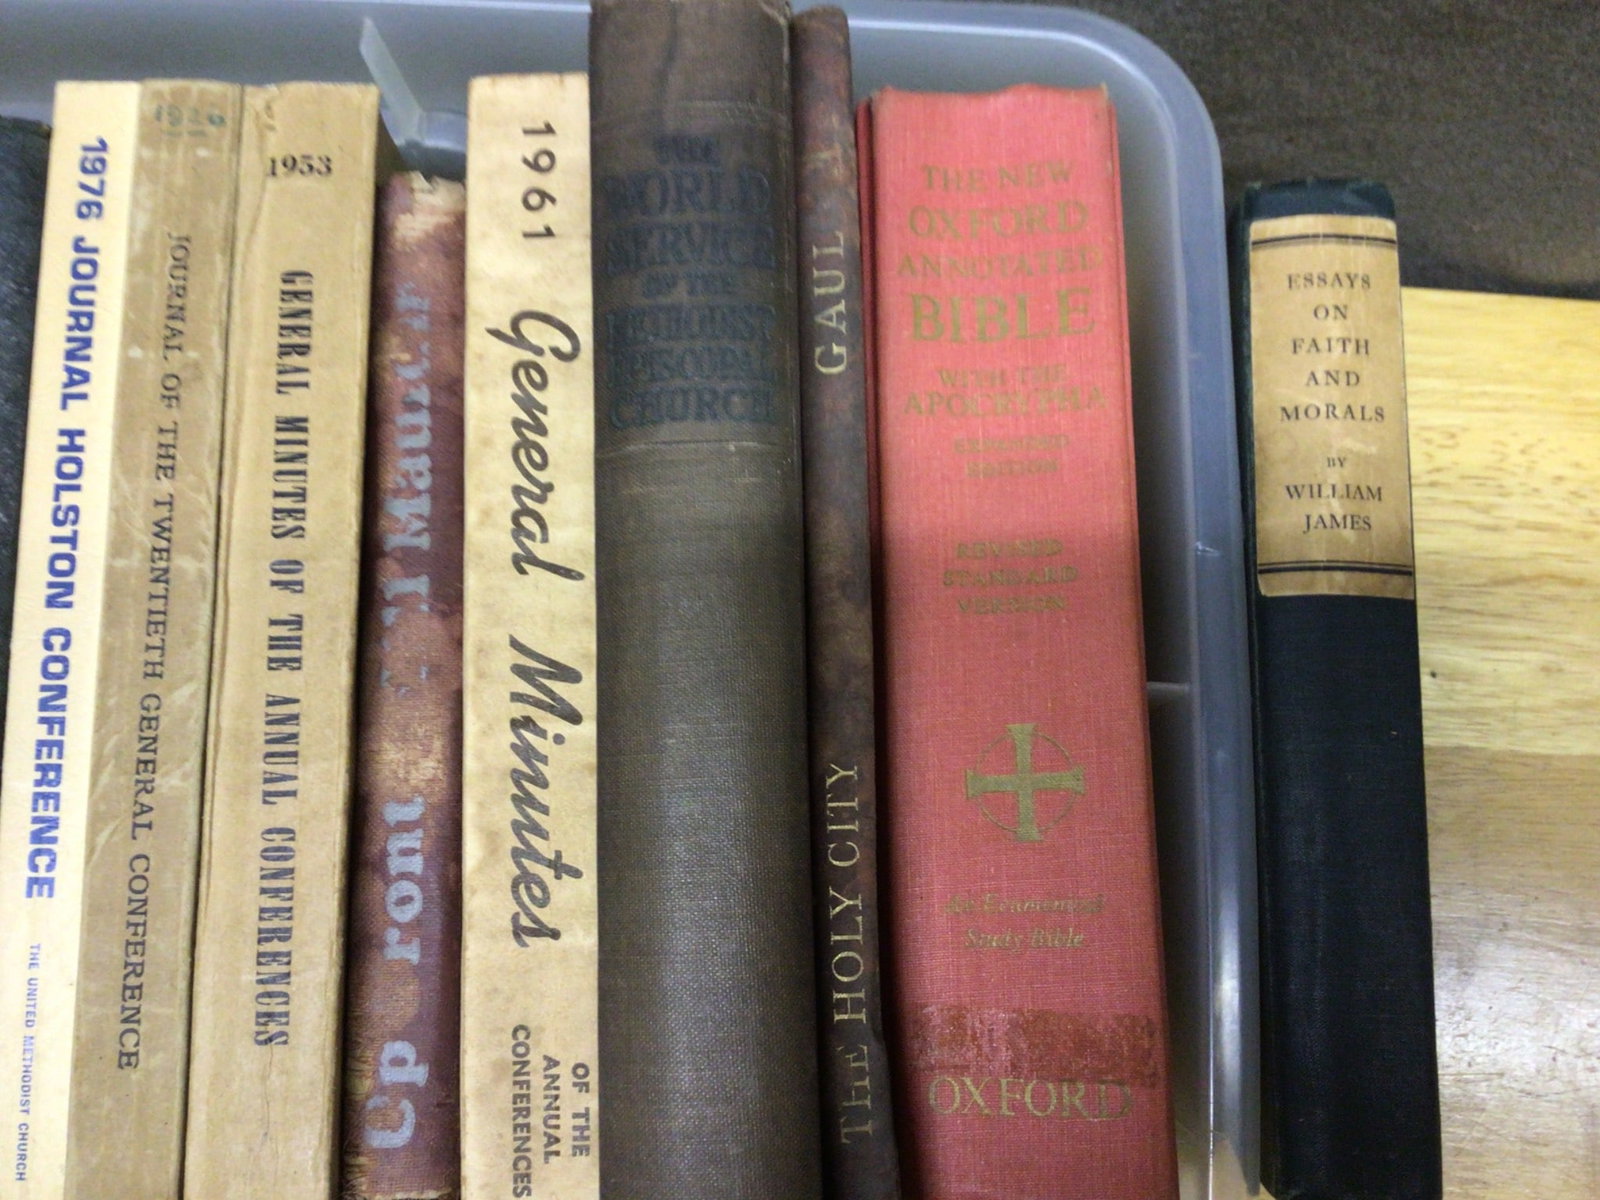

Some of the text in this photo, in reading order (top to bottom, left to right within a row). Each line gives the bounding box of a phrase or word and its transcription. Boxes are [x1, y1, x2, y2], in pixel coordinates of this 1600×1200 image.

[267, 153, 333, 178] 1953
[921, 159, 1074, 193] THE NEW
[907, 199, 1090, 241] OXFORD
[897, 245, 1104, 280] ANNOTATED
[1287, 271, 1372, 290] ESSAYS
[812, 230, 847, 376] GAUL
[909, 286, 1097, 344] BIBLE
[1313, 303, 1349, 322] ON
[1291, 336, 1370, 356] FAITH
[1305, 370, 1361, 387] AND
[609, 383, 777, 430] CHURCH
[1280, 403, 1386, 422] MORALS
[1326, 456, 1347, 469] BY
[1285, 482, 1384, 502] WILLIAM
[25, 137, 109, 900] 1976 JOURNAL HOLSTON CONFERENCE
[485, 121, 585, 948] 1961 General Minutes
[1302, 514, 1373, 535] JAMES
[943, 564, 1079, 587] STANDARD
[117, 231, 192, 1070] JOURNAL OF THE TWENTIETH GENERAL CONFERENCE
[253, 269, 315, 1047] GENERAL MINUTES OF THE ANNUAL CONFERENCES
[381, 793, 427, 980] ront
[826, 761, 874, 1145] THE HOLY CITY
[15, 942, 42, 1182] THE UNITED METHODIST CHURCH
[511, 1023, 533, 1199] CONFERENCES
[541, 1054, 562, 1165] ANNUAL
[571, 1062, 591, 1158] OF THE
[926, 1075, 1135, 1121] OXFORD
